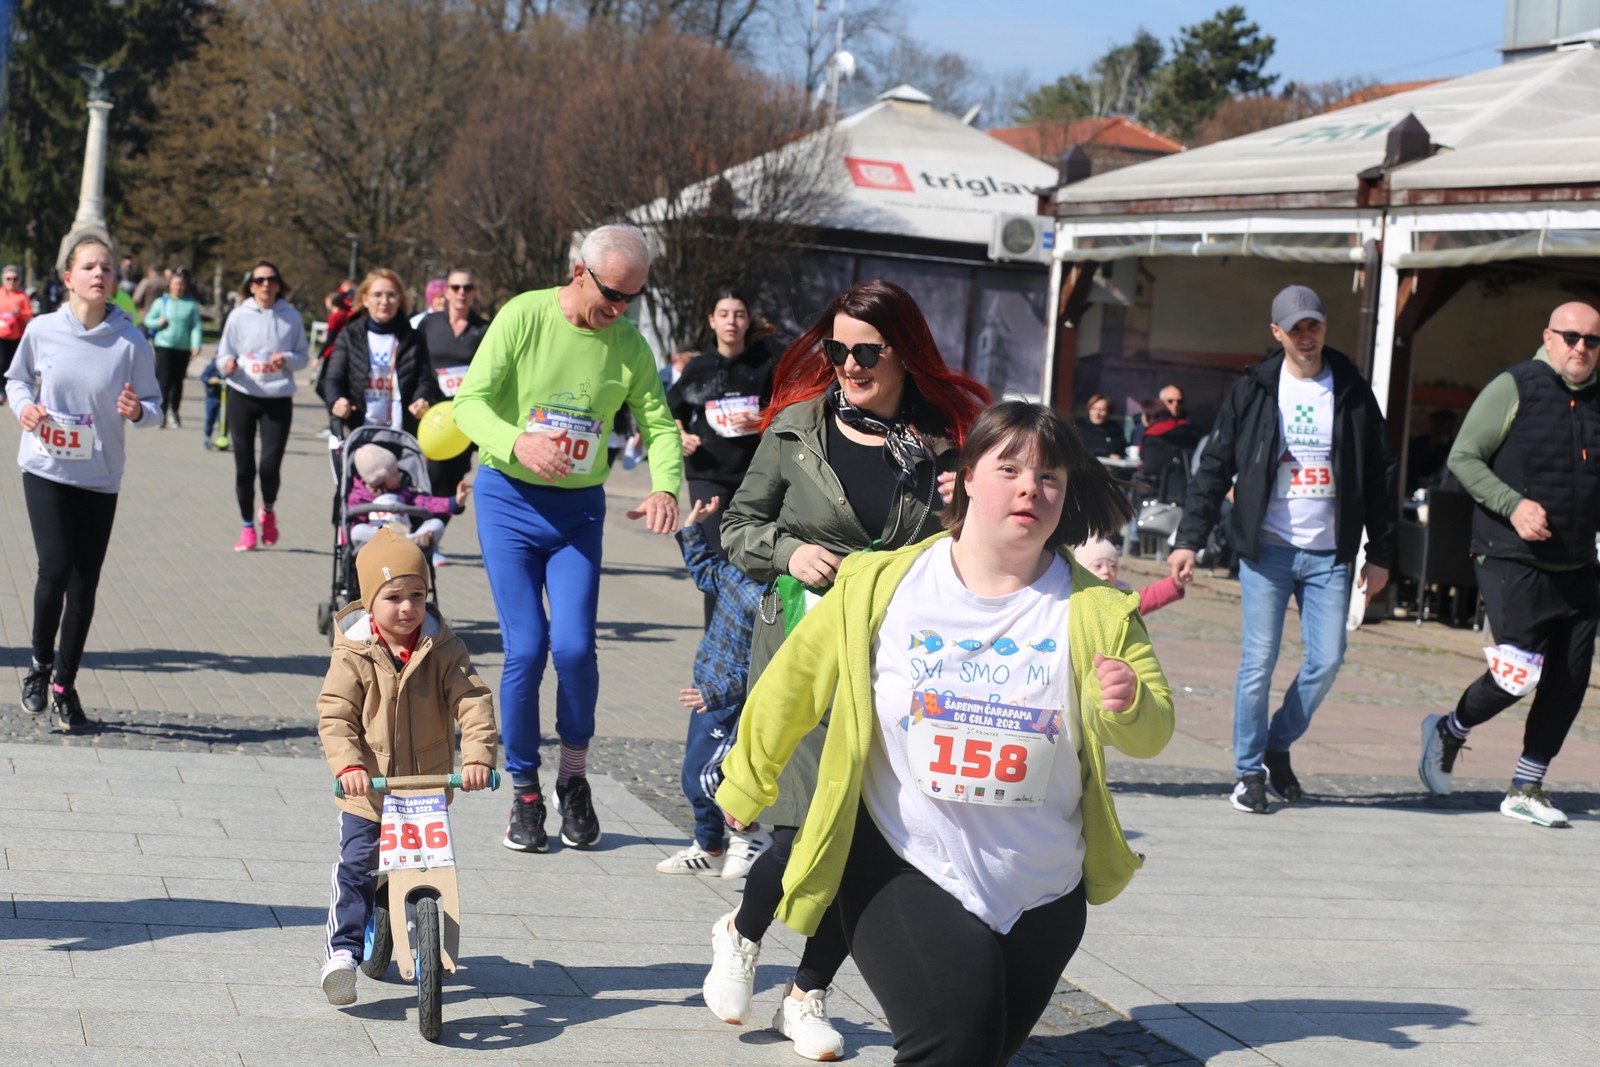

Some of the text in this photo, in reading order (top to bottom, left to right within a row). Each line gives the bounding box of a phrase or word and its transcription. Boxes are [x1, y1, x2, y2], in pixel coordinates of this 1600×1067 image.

[40, 424, 81, 448] 461
[1287, 424, 1319, 434] KEEP
[1290, 467, 1330, 486] 153
[910, 657, 1050, 686] SVI SMO MI
[1491, 657, 1528, 685] 172
[944, 697, 983, 714] ŠARENIM
[984, 703, 1032, 721] ČARAPAMA
[953, 712, 967, 723] DO
[969, 714, 993, 727] CILJA
[996, 718, 1021, 730] 2023.
[929, 734, 1028, 783] 158
[380, 821, 448, 852] 586
